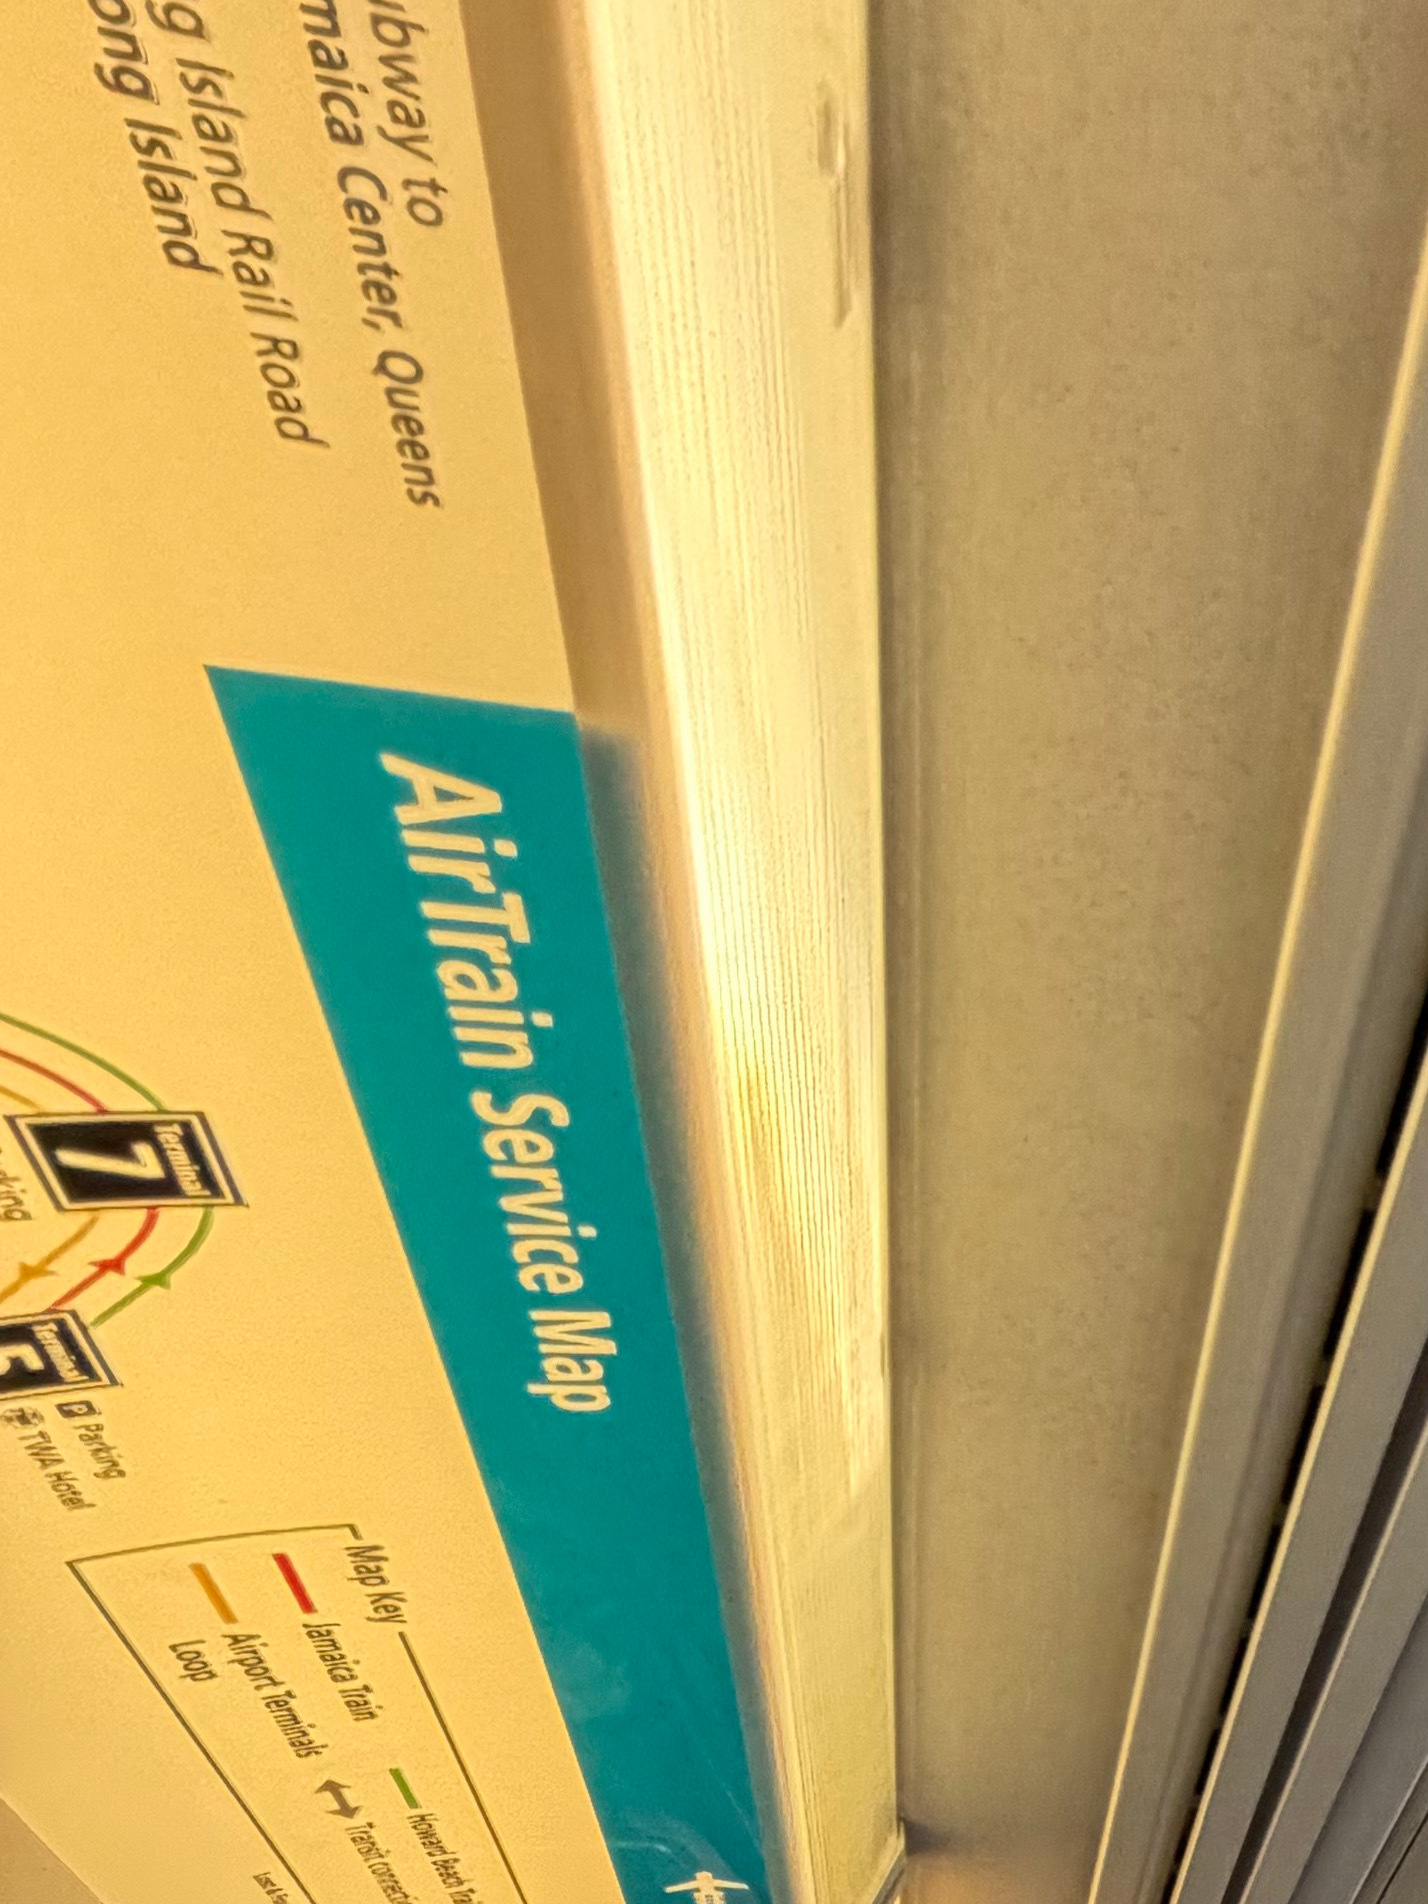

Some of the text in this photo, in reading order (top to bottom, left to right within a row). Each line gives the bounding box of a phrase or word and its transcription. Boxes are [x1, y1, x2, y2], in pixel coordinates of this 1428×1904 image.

[178, 58, 273, 225] Island
[124, 117, 224, 276] Island
[401, 175, 448, 229] to
[221, 224, 298, 326] Rail
[336, 165, 402, 332] Center,
[370, 348, 442, 510] Queens
[251, 332, 332, 448] Road
[379, 752, 617, 1414] AirTrain Service Map
[54, 1122, 213, 1197] Terminal 7
[18, 1429, 97, 1513] TWA Hotel
[73, 1422, 128, 1481] Parking
[344, 1543, 408, 1625] Map Key
[168, 1639, 218, 1683] Loop
[221, 1633, 330, 1759] Airport Terminals
[302, 1622, 384, 1723] Jamaica Train
